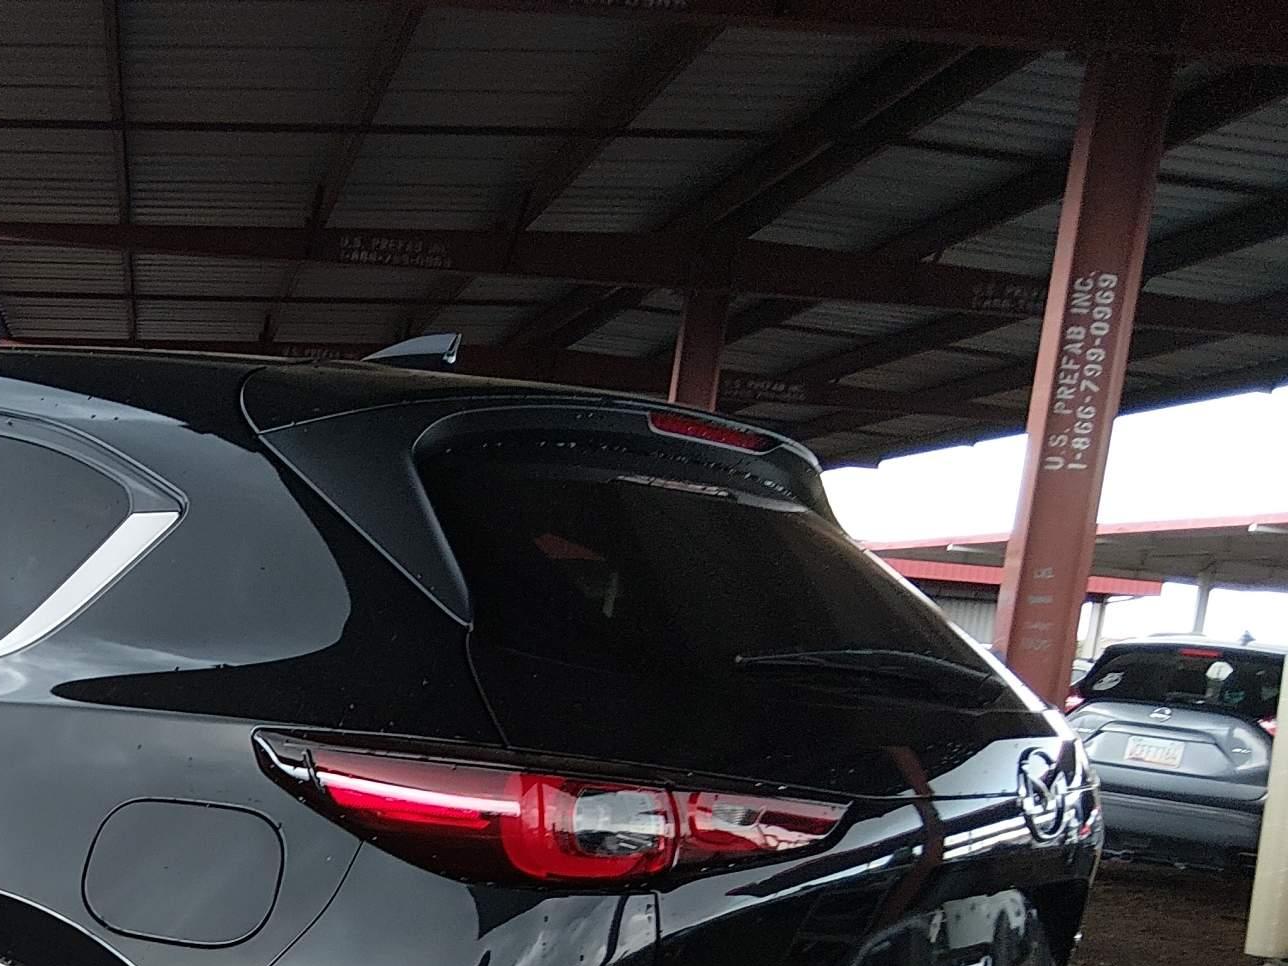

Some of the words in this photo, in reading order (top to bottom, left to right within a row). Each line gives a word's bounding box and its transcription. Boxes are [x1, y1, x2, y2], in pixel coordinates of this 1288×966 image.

[1071, 270, 1098, 314] INC.
[1053, 325, 1086, 415] PREFAB
[1067, 272, 1119, 470] 1-866-799-0969
[1044, 428, 1071, 471] U.S.
